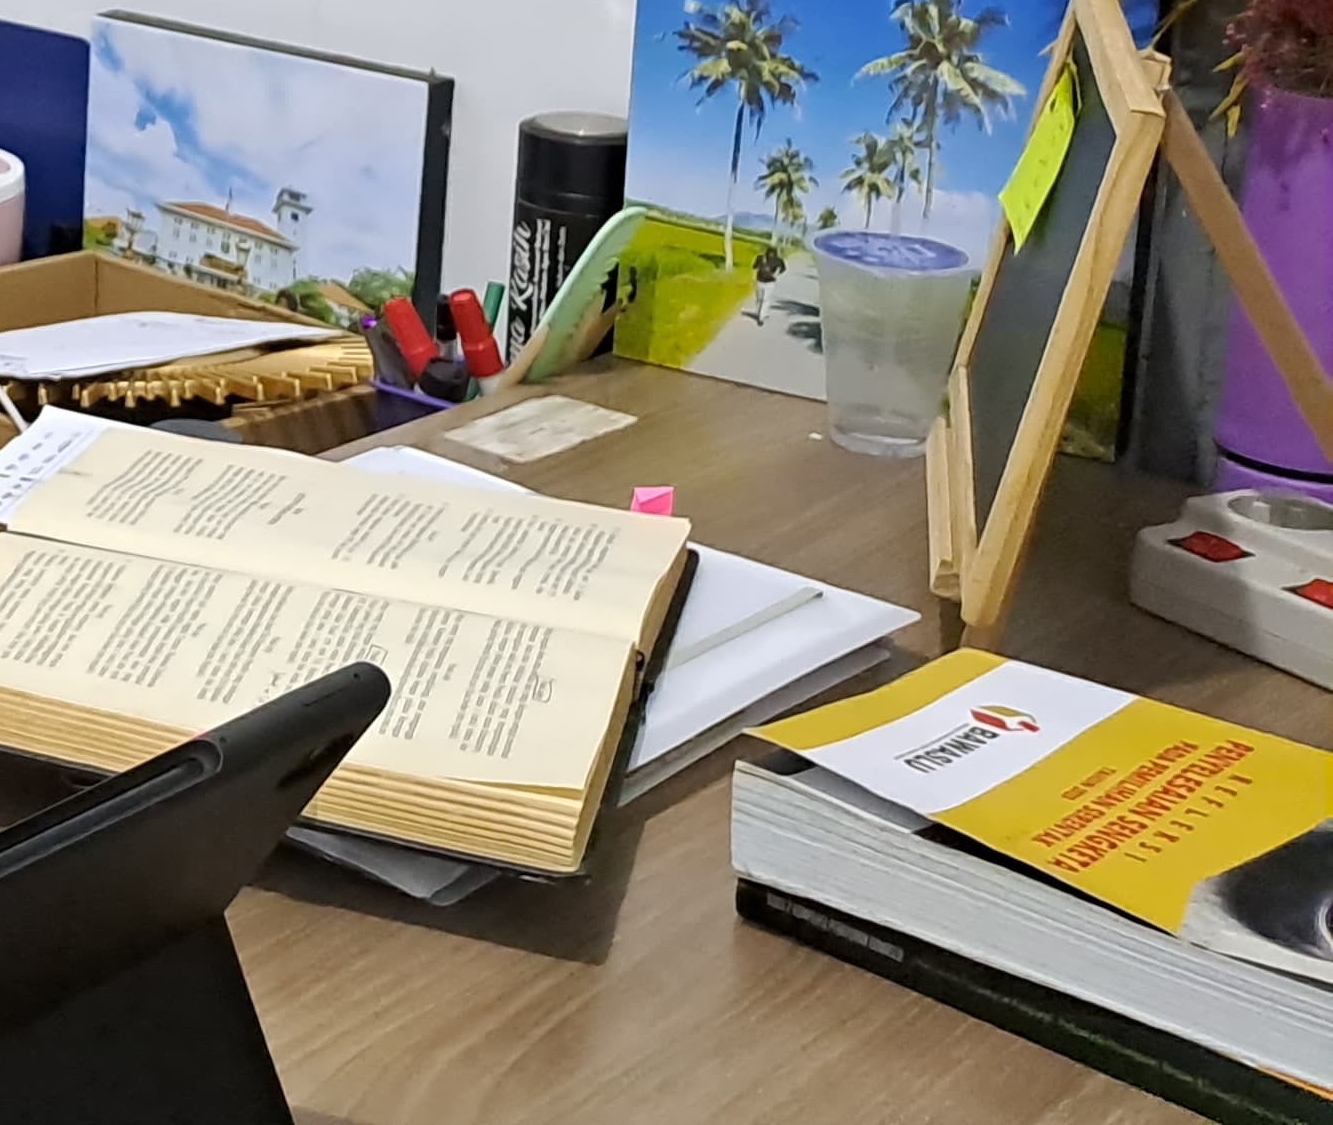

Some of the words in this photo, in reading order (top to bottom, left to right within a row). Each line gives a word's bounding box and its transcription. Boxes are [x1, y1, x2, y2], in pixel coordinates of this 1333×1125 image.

[510, 221, 532, 311] Kasih
[902, 728, 997, 775] BAWASLU
[1126, 738, 1255, 823] PENYELESAIAN
[1047, 813, 1149, 874] SENGKETA
